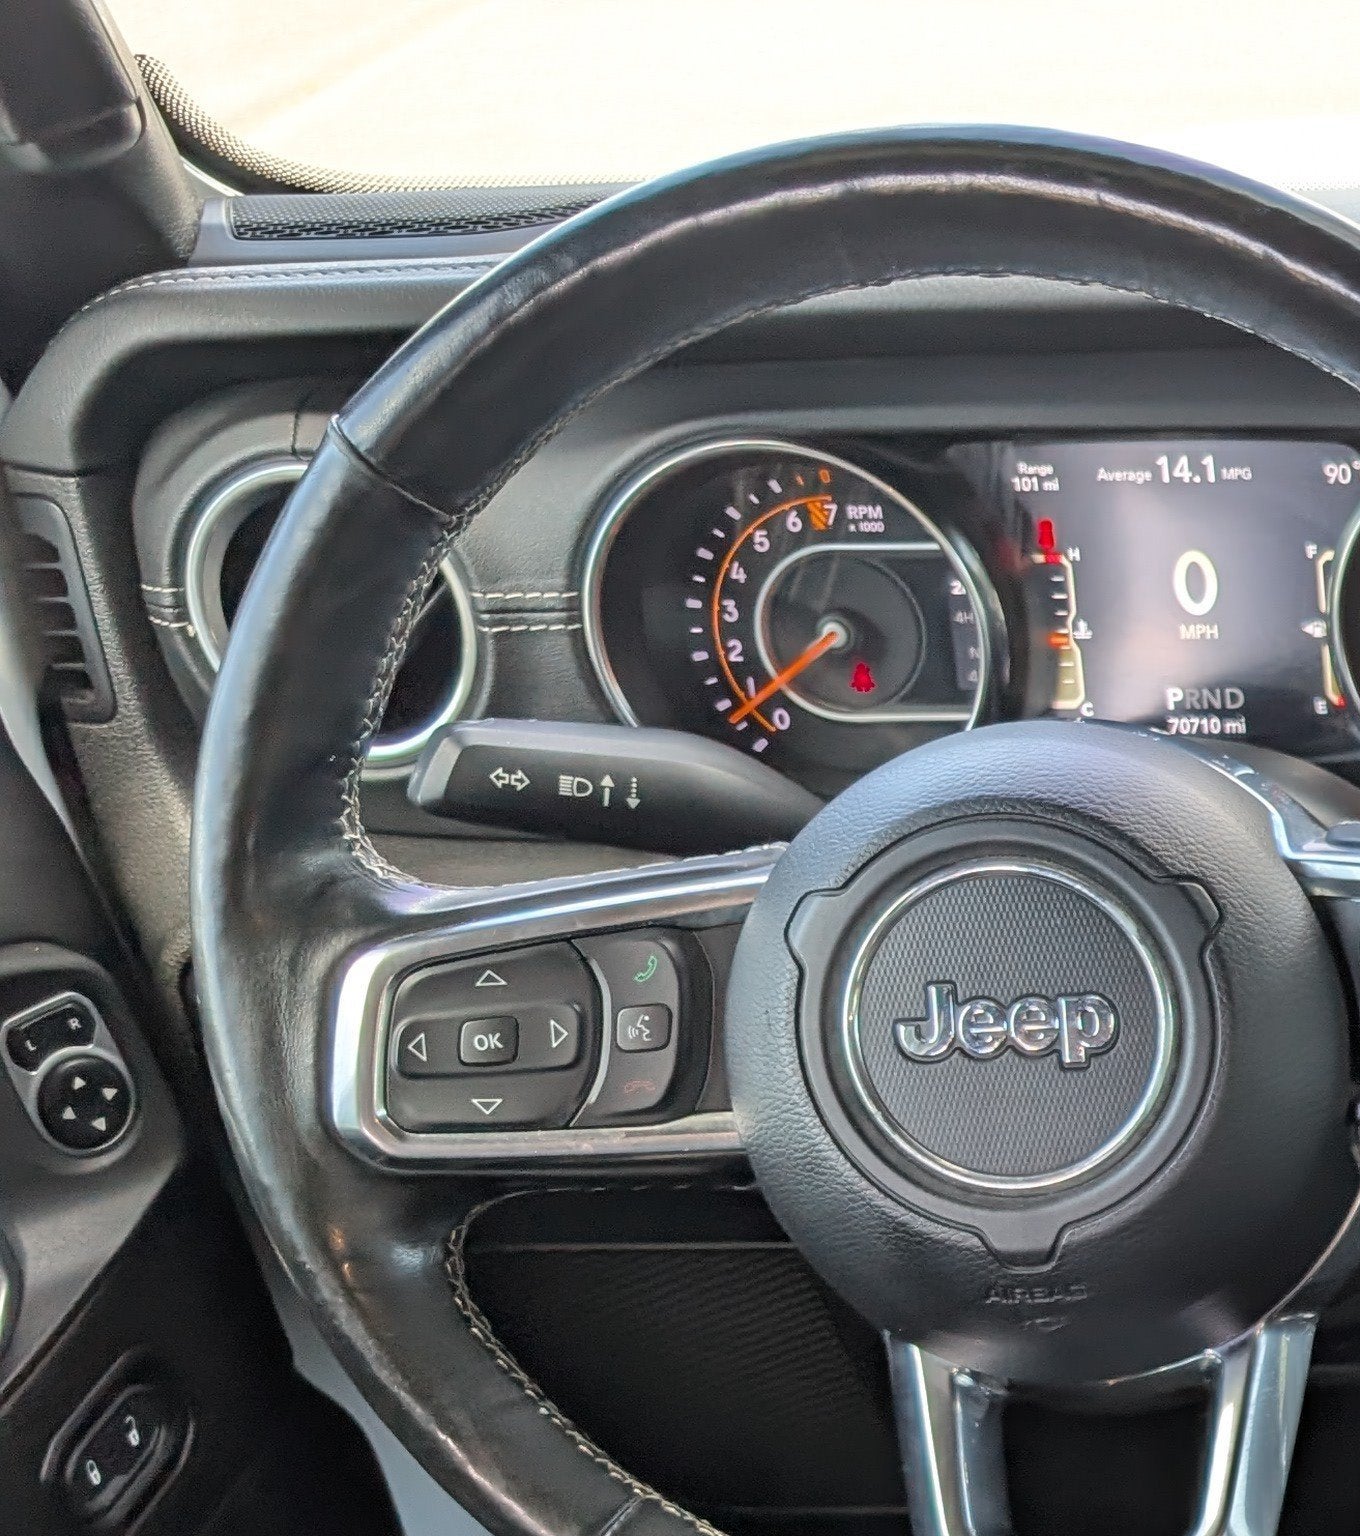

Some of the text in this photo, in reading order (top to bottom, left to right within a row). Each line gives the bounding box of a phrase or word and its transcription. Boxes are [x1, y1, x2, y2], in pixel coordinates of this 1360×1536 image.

[1016, 462, 1054, 476] Range
[1097, 454, 1252, 484] Average 14.1 MPG
[1012, 475, 1060, 492] 101 mi
[786, 511, 803, 533] 6
[822, 502, 838, 526] 7
[846, 504, 883, 520] RPM
[752, 530, 770, 553] 5
[730, 562, 747, 583] 4
[1172, 549, 1218, 616] 0
[722, 600, 740, 622] 3
[1179, 624, 1219, 640] MPH
[726, 639, 744, 663] 2
[1166, 686, 1245, 709] PRND
[773, 706, 792, 732] 0
[1167, 717, 1247, 735] 70710 mi
[896, 981, 1119, 1070] Jeep
[473, 1031, 504, 1051] OK
